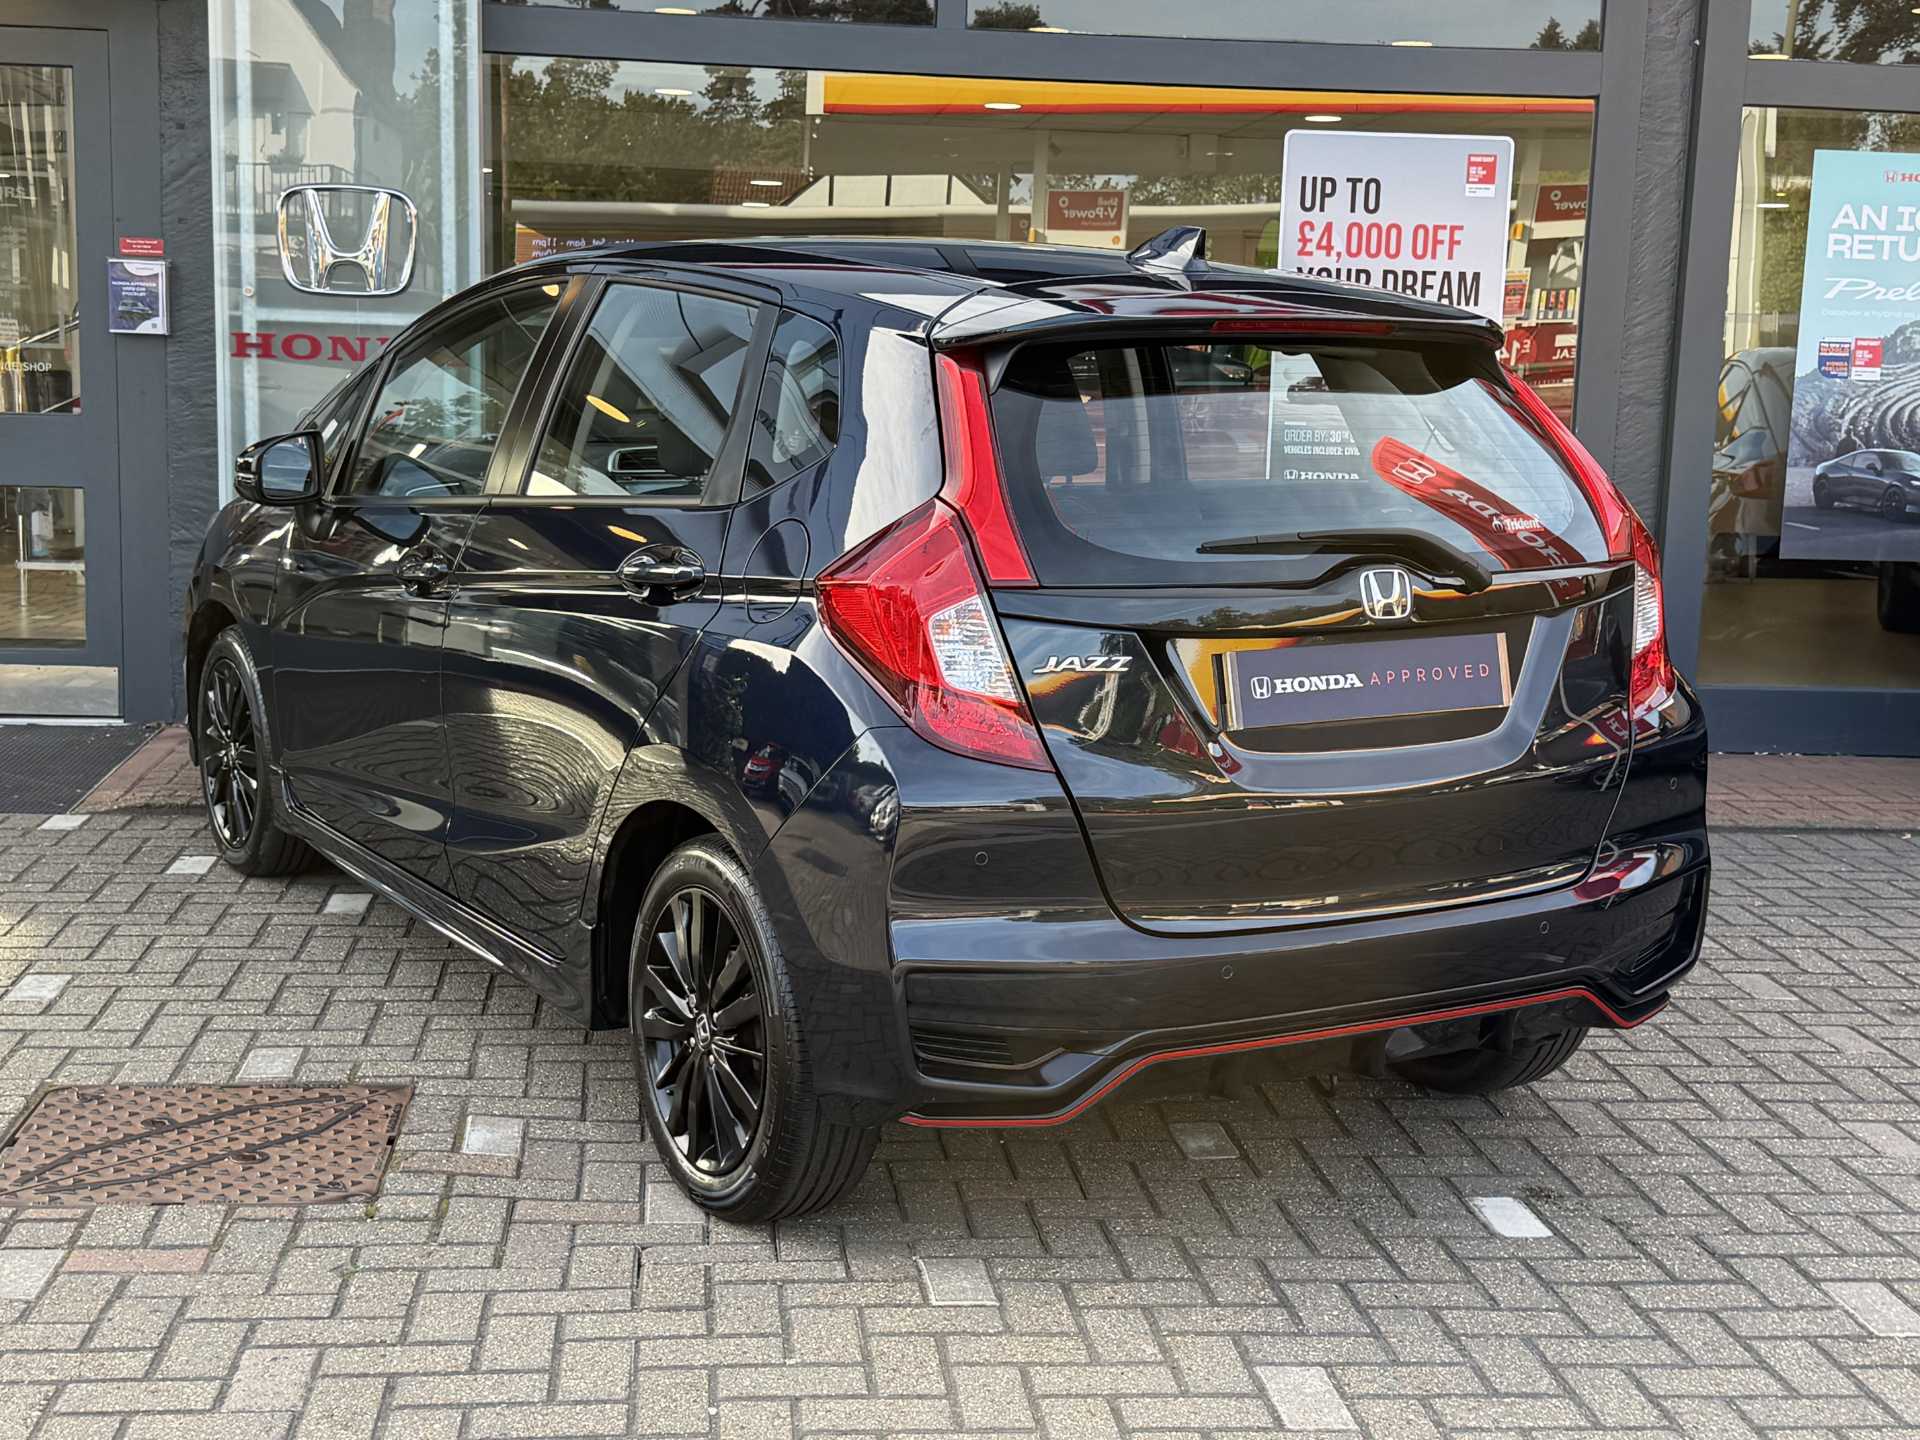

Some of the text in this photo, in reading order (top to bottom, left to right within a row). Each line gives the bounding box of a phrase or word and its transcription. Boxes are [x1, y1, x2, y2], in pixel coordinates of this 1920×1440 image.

[1300, 176, 1382, 214] UP TO
[1831, 203, 1888, 231] AN
[1297, 220, 1464, 263] £4,000 OFF
[1827, 233, 1920, 262] RETU
[230, 332, 389, 362] HON
[23, 361, 52, 372] SHOP
[1284, 430, 1312, 442] ORDER
[1300, 471, 1360, 480] HONDA
[1505, 517, 1541, 531] Trident
[1032, 655, 1133, 674] JAZZ
[1273, 663, 1490, 694] HONDA APPROVED
